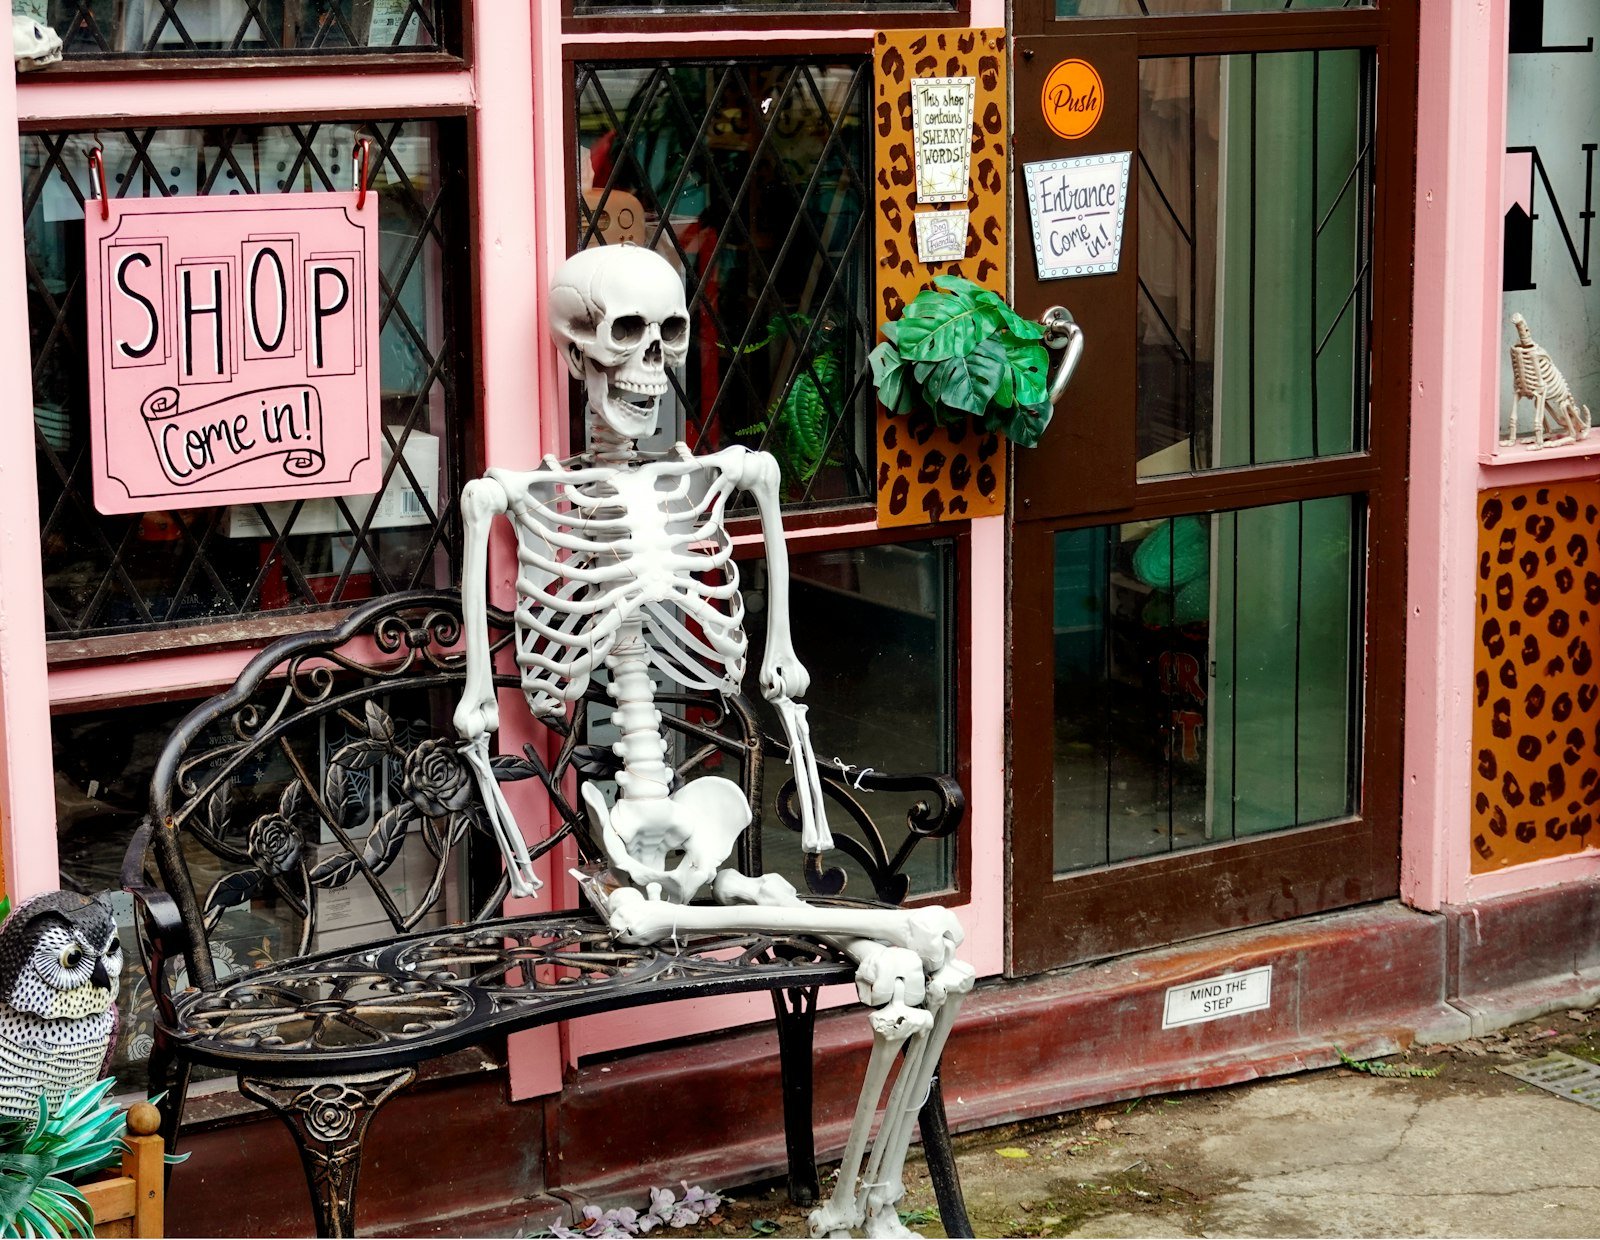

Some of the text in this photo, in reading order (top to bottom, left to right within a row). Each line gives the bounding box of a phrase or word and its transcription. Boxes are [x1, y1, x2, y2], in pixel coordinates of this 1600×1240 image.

[920, 88, 964, 113] This shop
[1049, 83, 1097, 114] Push
[924, 108, 963, 125] contains
[922, 128, 965, 145] SWEARY
[923, 146, 964, 164] WORDS!
[1040, 174, 1115, 213] Entrance
[933, 223, 947, 236] Dog
[1050, 223, 1112, 259] Come in!
[115, 246, 349, 376] SHOP
[160, 391, 312, 478] Come in!
[1190, 979, 1247, 1001] MIND THE
[1203, 997, 1233, 1013] STEP
